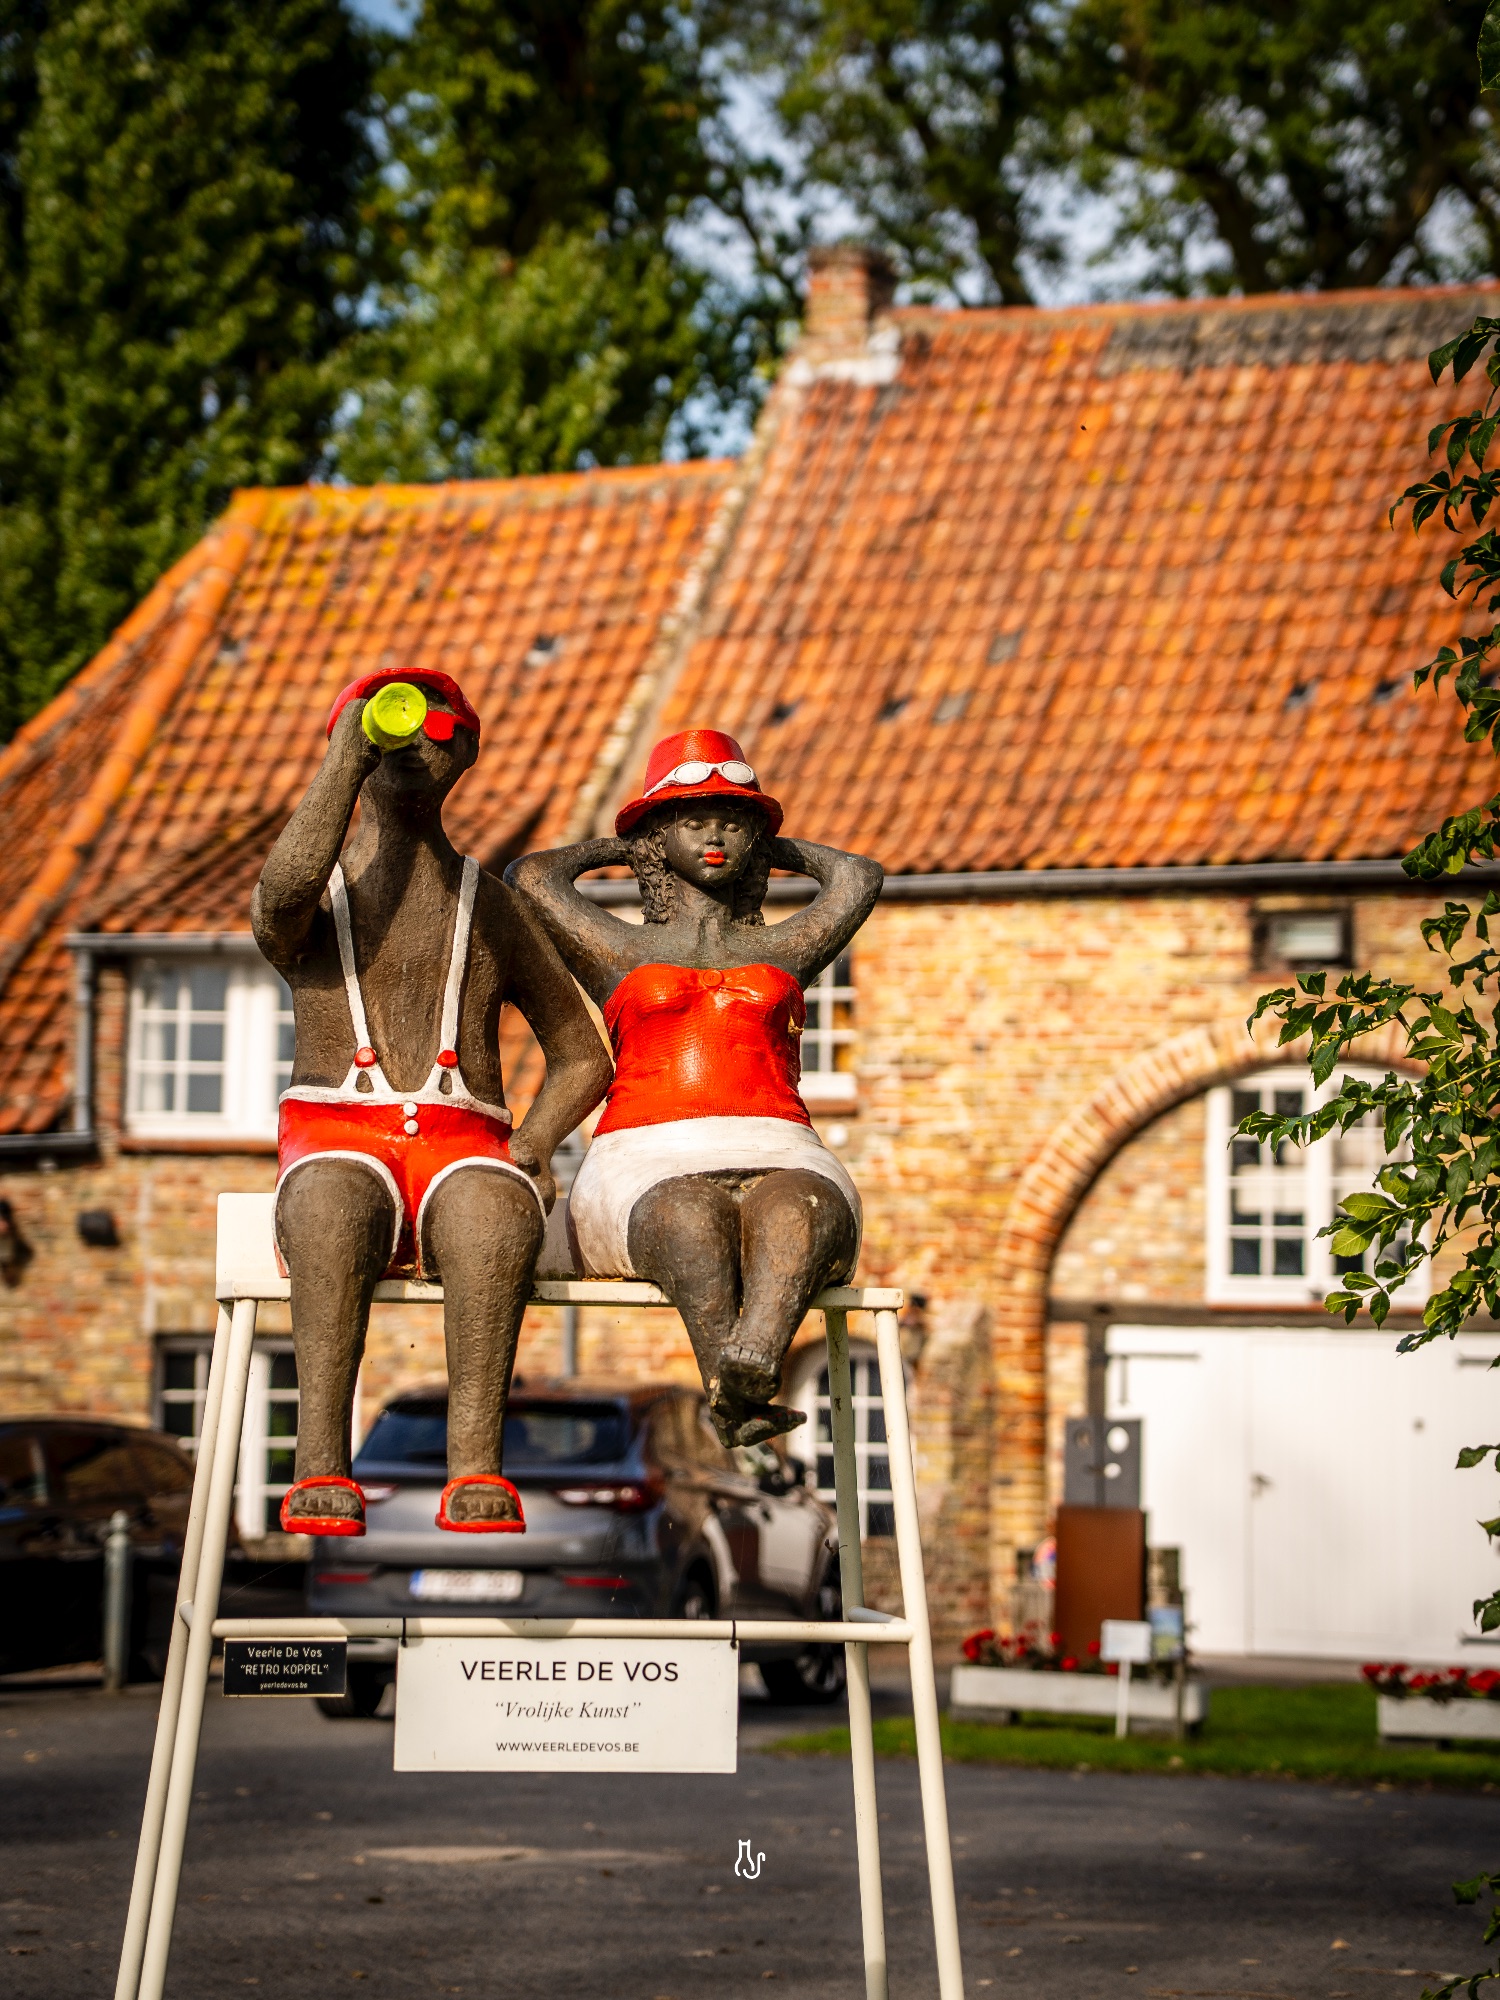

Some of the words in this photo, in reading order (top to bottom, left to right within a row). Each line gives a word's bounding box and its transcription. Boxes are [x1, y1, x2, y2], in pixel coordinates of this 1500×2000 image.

[247, 1646, 283, 1658] Veerle
[285, 1646, 299, 1658] De
[302, 1646, 323, 1658] Vos
[460, 1660, 567, 1681] VEERLE
[577, 1661, 614, 1682] DE
[623, 1661, 679, 1682] VOS
[495, 1701, 574, 1721] “Vrolijke
[579, 1701, 641, 1718] Kunst”
[496, 1742, 638, 1753] WWW.VEERLEDEVOS.BE
